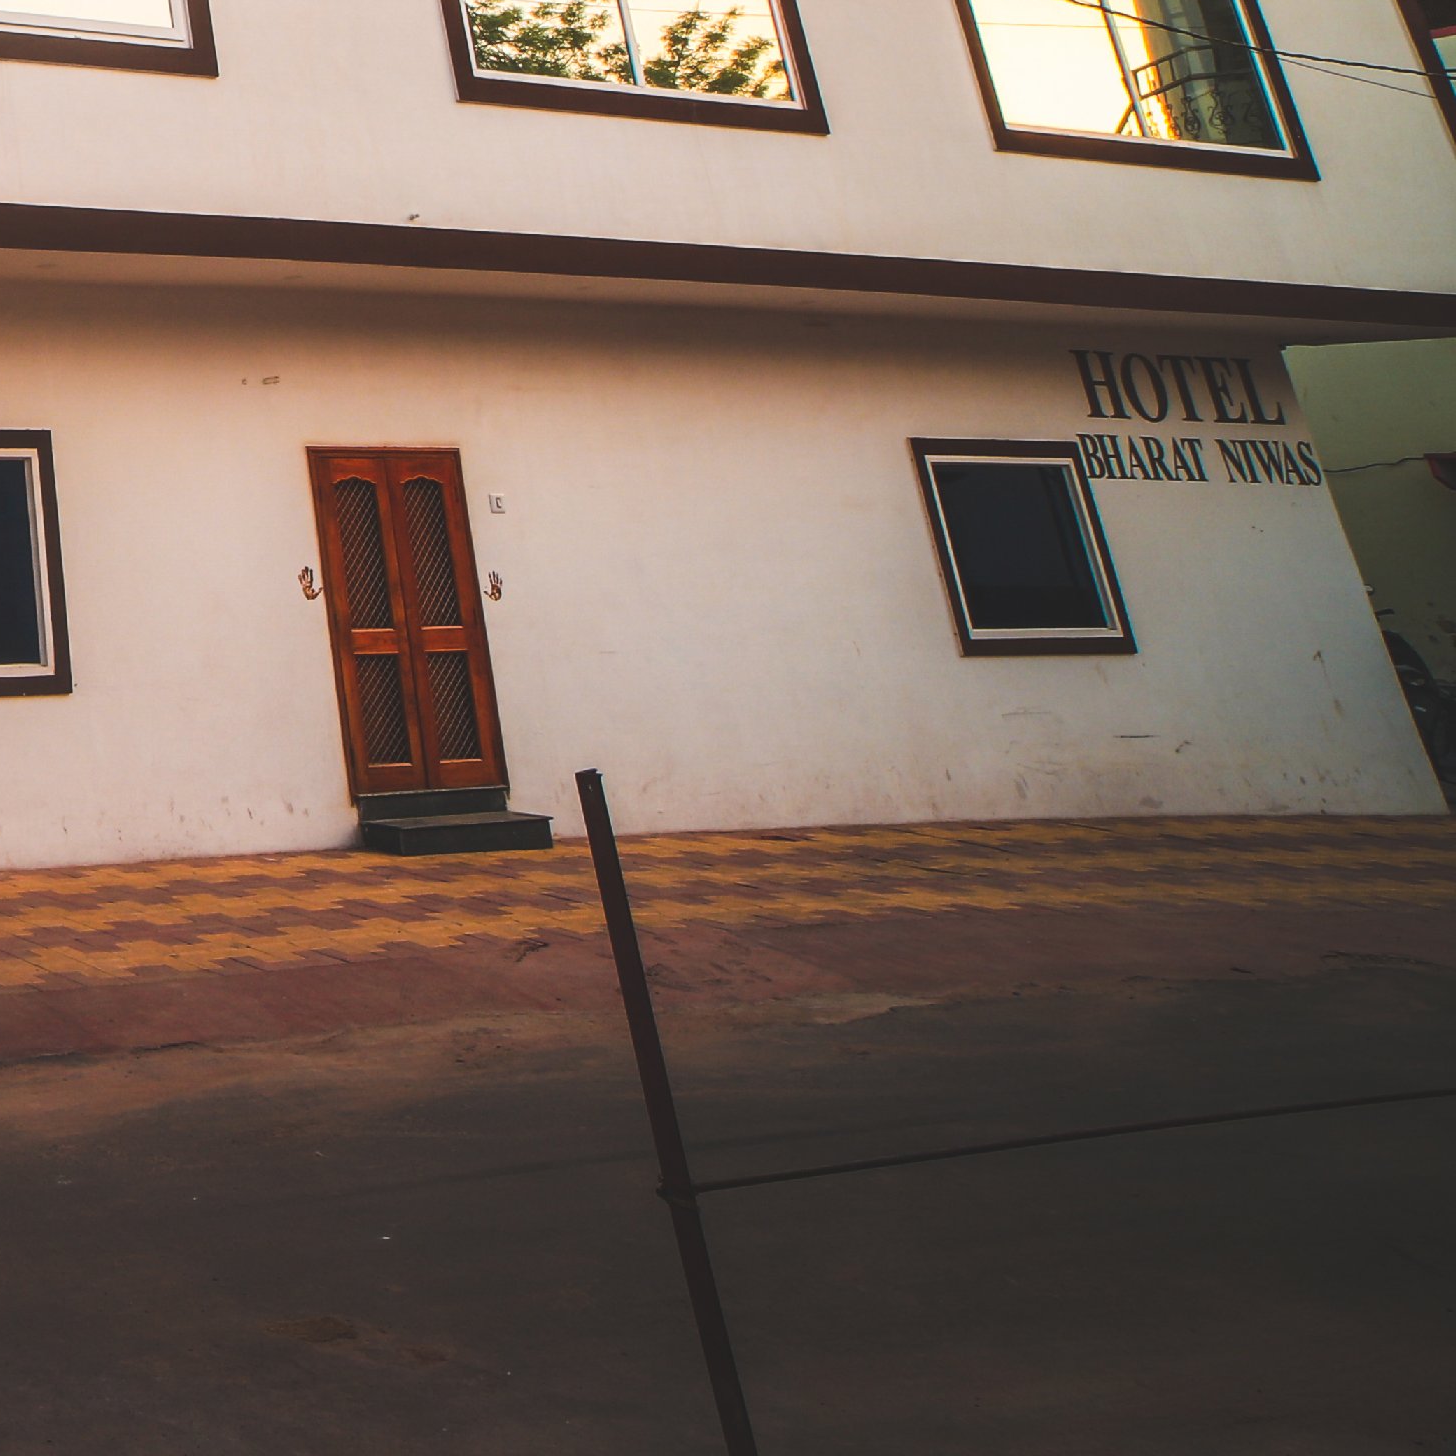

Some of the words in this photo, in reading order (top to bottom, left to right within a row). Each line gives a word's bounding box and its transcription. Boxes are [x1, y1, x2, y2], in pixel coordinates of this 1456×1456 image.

[1068, 349, 1286, 426] HOTEL
[1075, 432, 1209, 483] BHARAT
[1214, 438, 1323, 487] NIWAS
